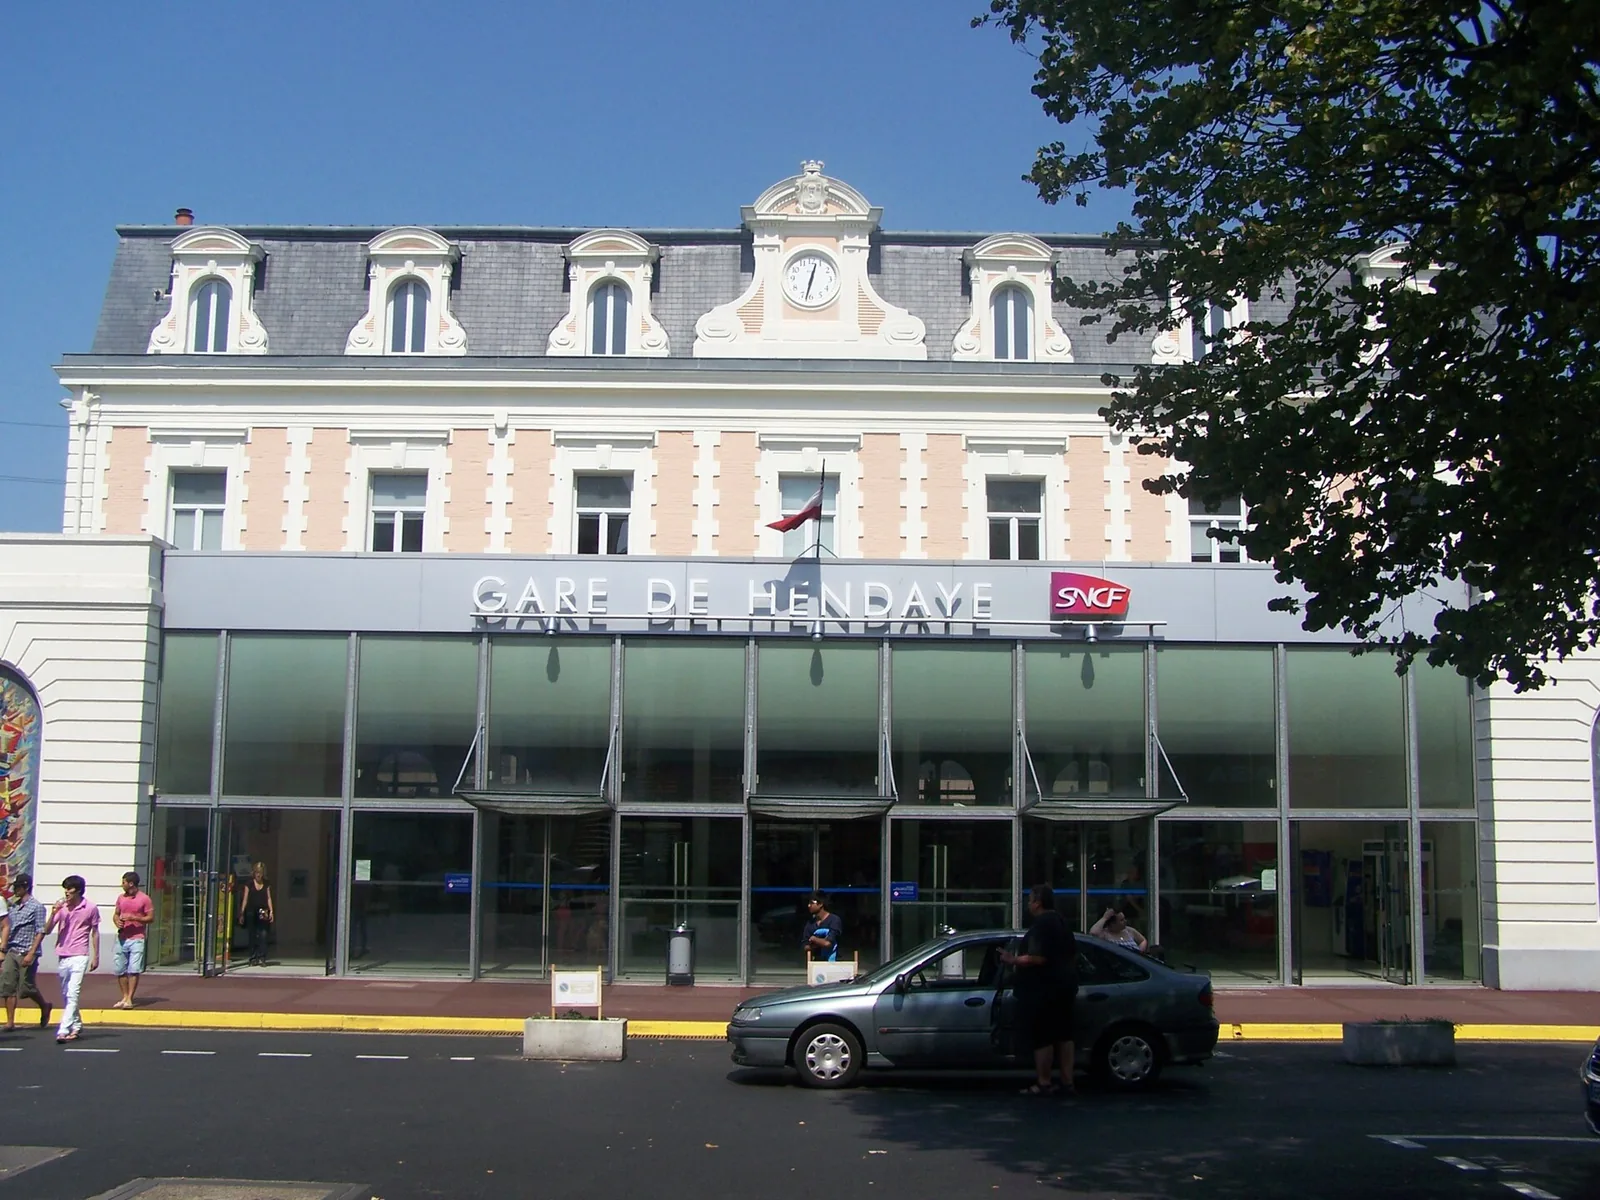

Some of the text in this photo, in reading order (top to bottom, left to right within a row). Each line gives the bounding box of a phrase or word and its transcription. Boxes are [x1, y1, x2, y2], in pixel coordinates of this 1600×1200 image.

[472, 575, 993, 619] GARE DE HENDAYE
[1055, 586, 1127, 608] SNCF
